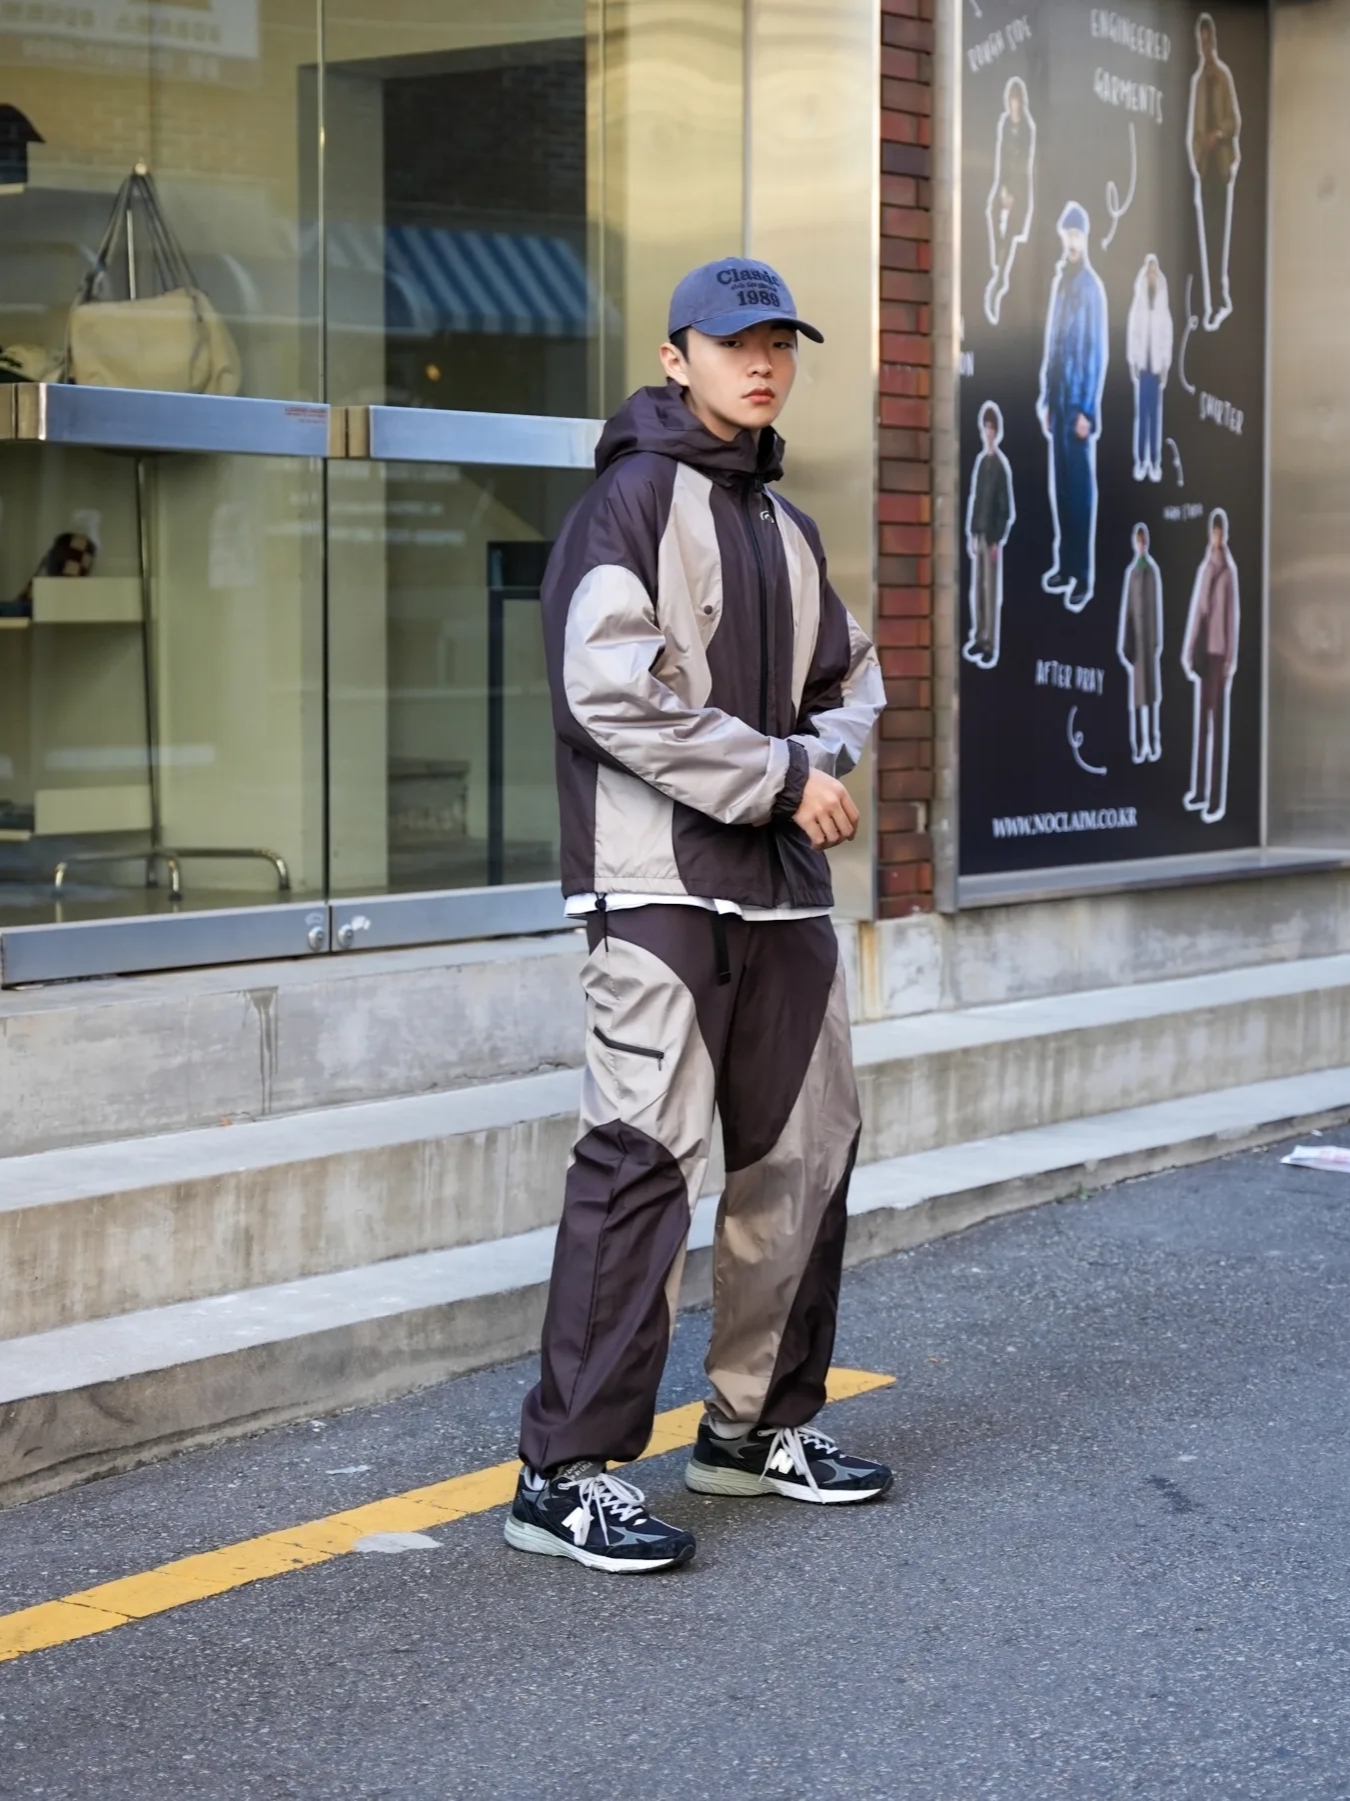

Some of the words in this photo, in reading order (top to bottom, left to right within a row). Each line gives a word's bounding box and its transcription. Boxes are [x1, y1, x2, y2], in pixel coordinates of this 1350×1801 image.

[1090, 8, 1171, 62] ENGINEERED
[1094, 66, 1163, 125] GARMENTS
[716, 268, 780, 287] Classic
[1034, 659, 1072, 689] AFTER
[1075, 665, 1105, 695] PRAY
[992, 806, 1137, 838] WWW.NOCLAIM.CO.KR
